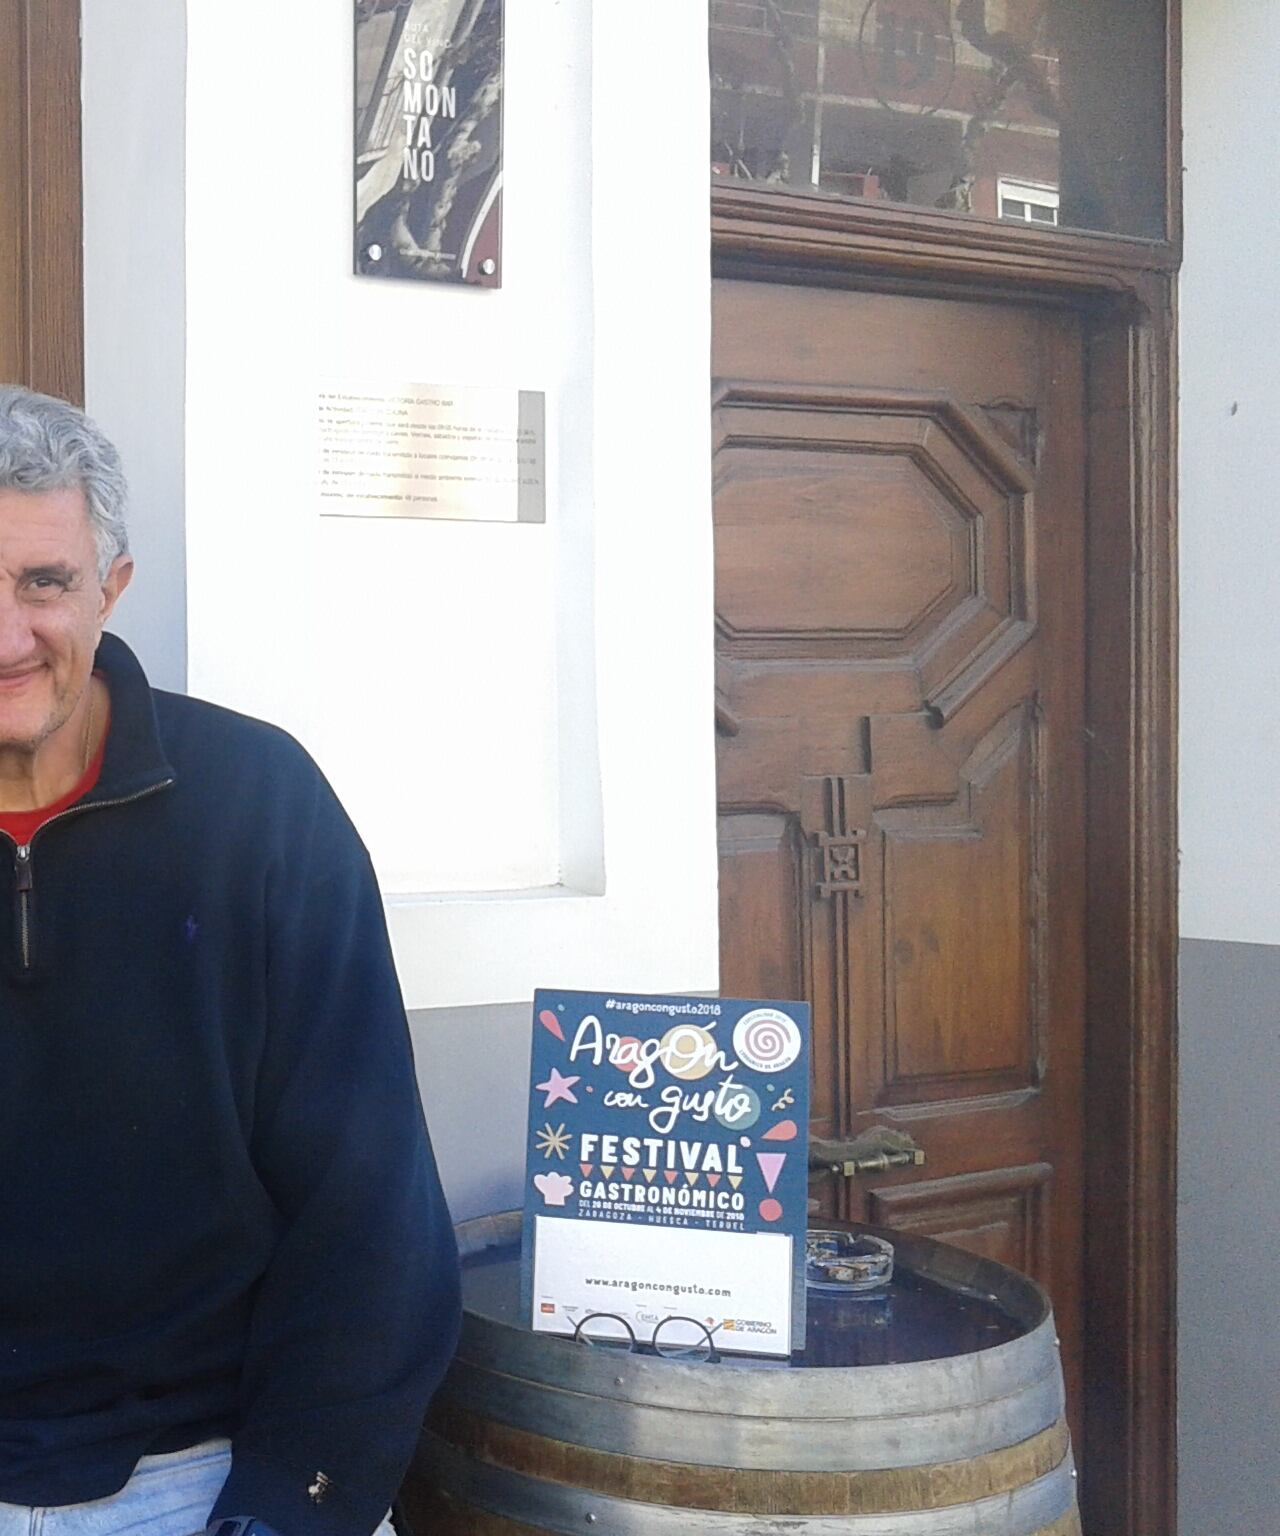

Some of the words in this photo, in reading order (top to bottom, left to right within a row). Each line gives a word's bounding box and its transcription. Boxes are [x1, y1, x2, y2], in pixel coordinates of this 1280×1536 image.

[404, 48, 433, 81] SO
[404, 81, 456, 118] MON
[404, 115, 431, 148] TA
[404, 147, 435, 182] NO
[605, 998, 721, 1016] #aragoncongusto2018
[603, 1090, 648, 1107] con
[649, 1074, 751, 1134] gusto
[580, 1133, 743, 1174] FESTIVAL
[580, 1181, 744, 1211] GASTRONÓMICO
[614, 1203, 645, 1212] OCTUBRE
[578, 1208, 632, 1220] ZARAGOZA
[649, 1215, 688, 1225] HUESCA
[705, 1220, 744, 1231] TERUEL
[585, 1277, 732, 1297] www.aragoncongusto.com
[736, 1319, 772, 1328] GOBIERNO
